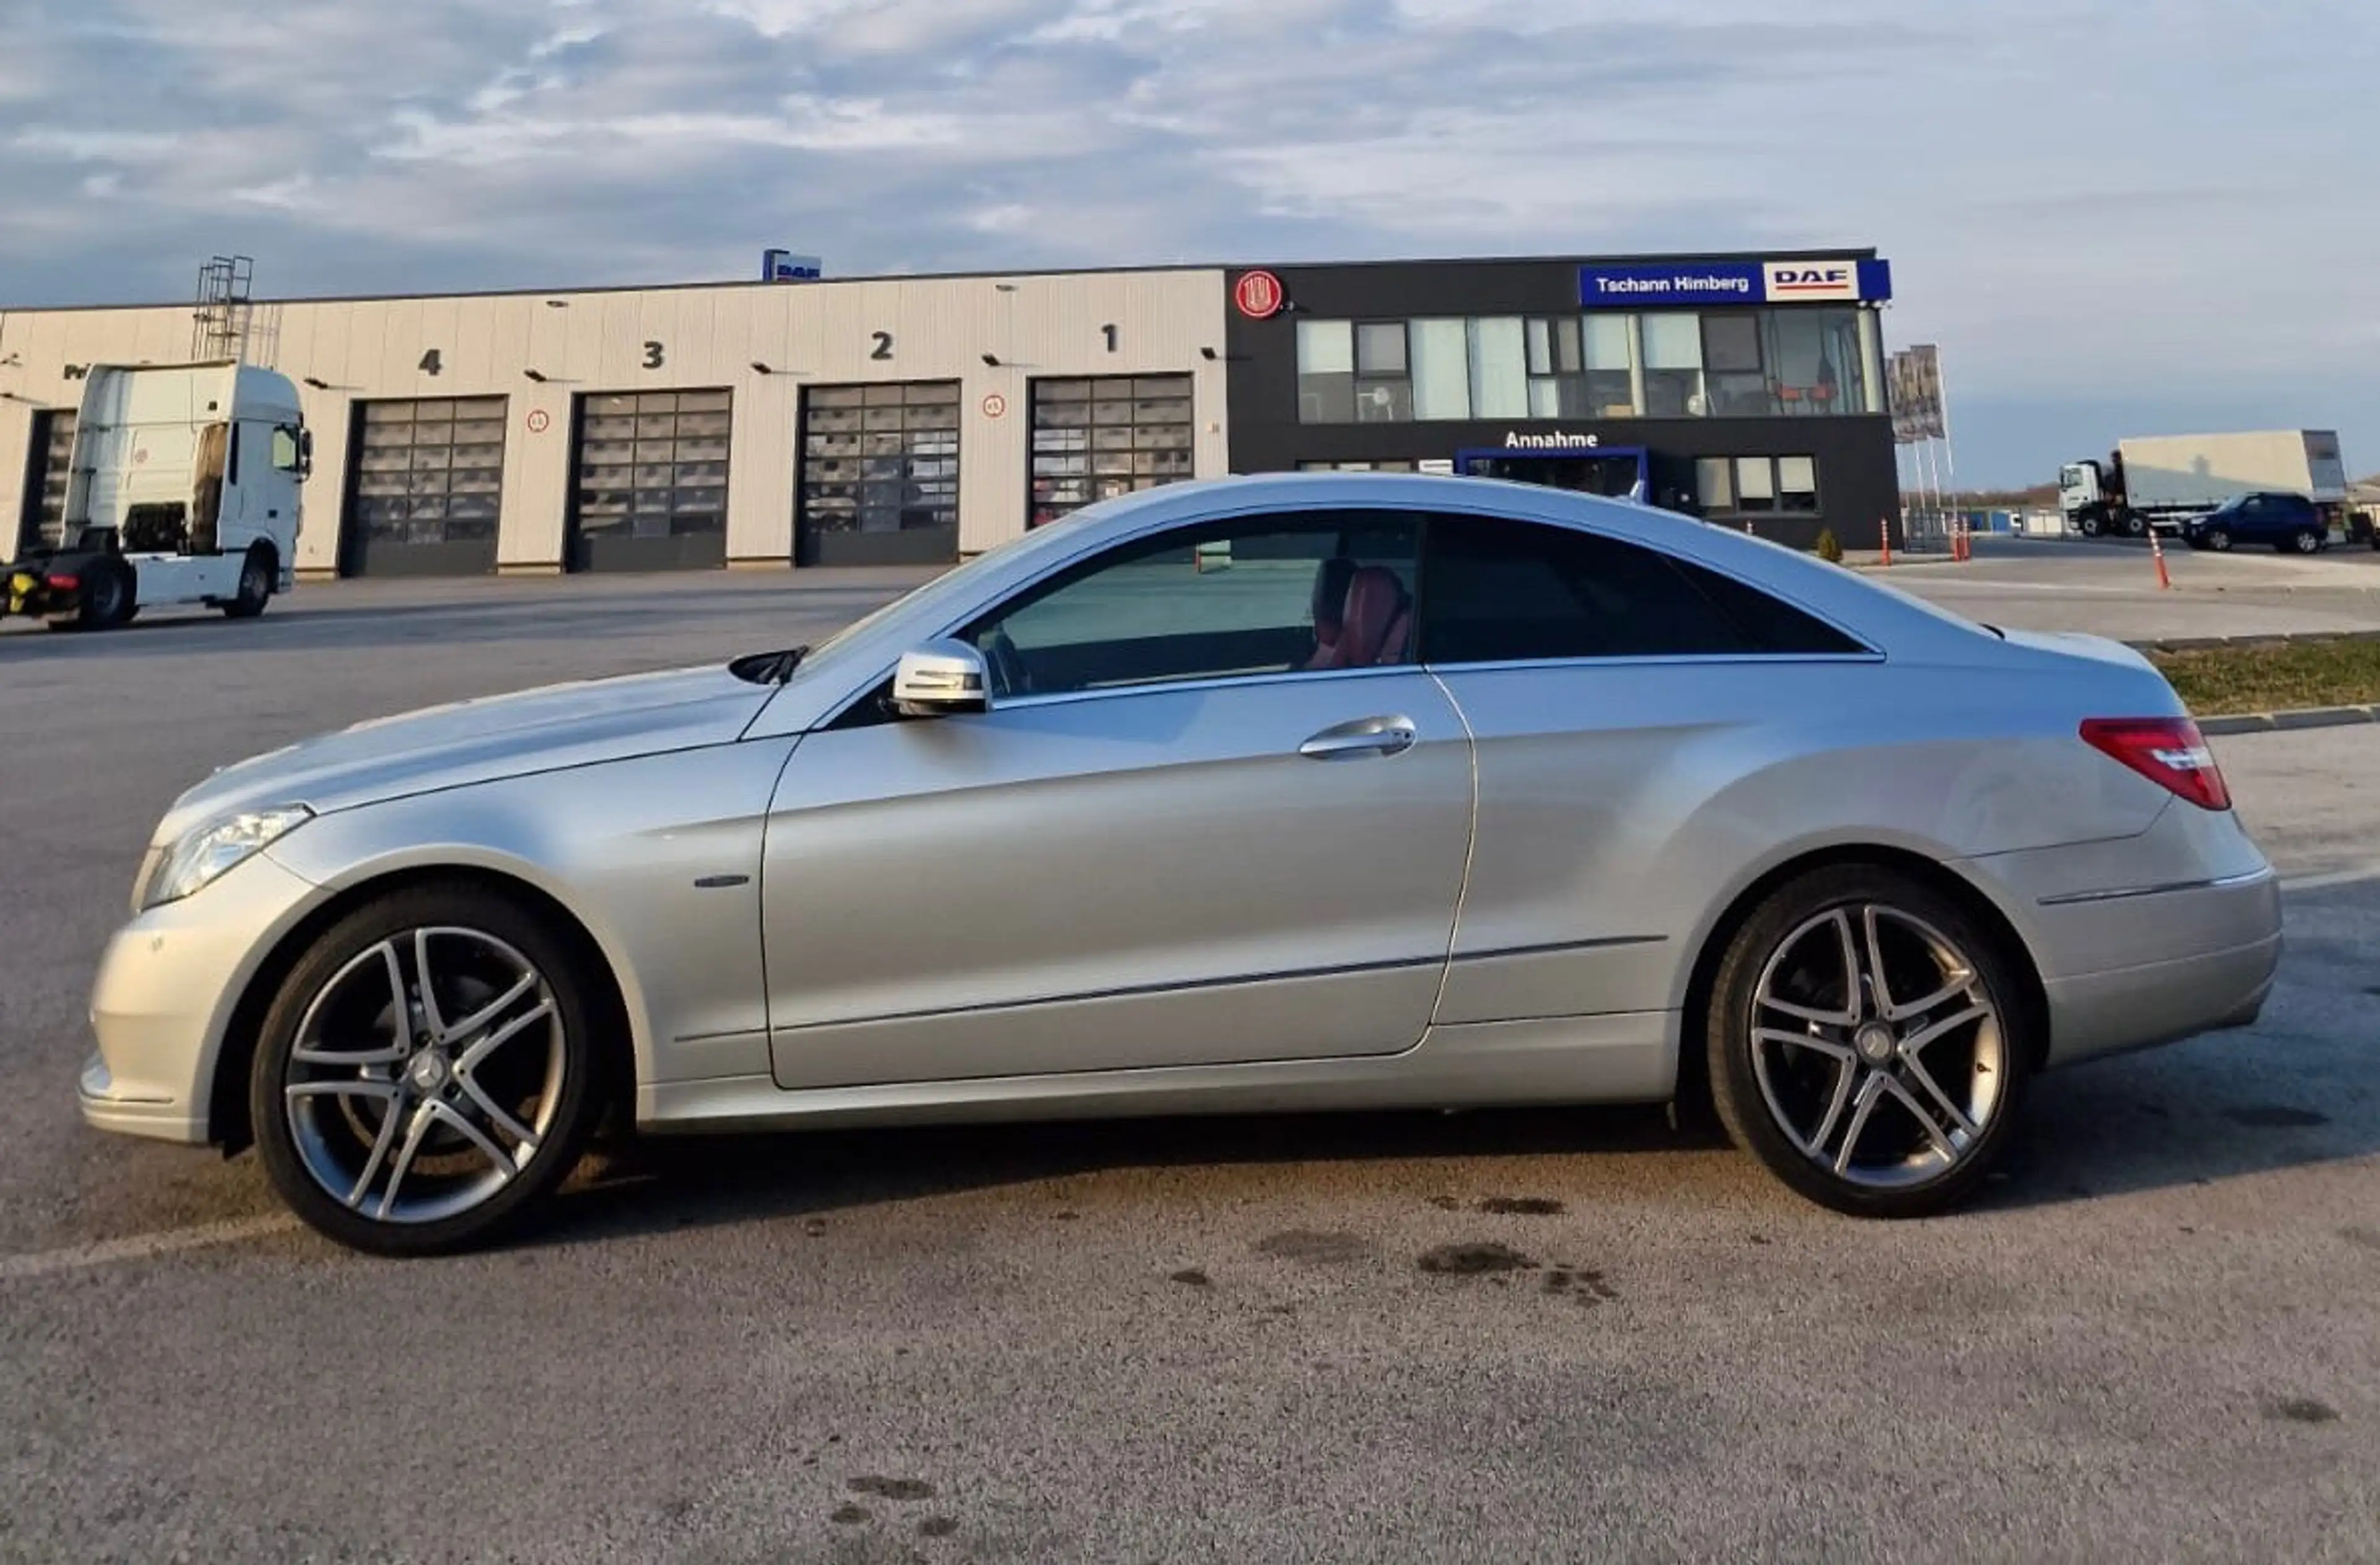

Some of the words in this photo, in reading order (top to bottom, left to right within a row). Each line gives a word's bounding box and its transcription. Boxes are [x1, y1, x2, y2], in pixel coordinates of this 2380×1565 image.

[1596, 278, 1671, 293] Tschann
[1675, 275, 1749, 292] Himberg
[1775, 270, 1847, 283] DAF
[871, 331, 893, 360] 2
[1101, 324, 1117, 353] 1
[418, 348, 443, 376] 4
[642, 341, 663, 369] 3
[1505, 430, 1598, 449] Annahme
